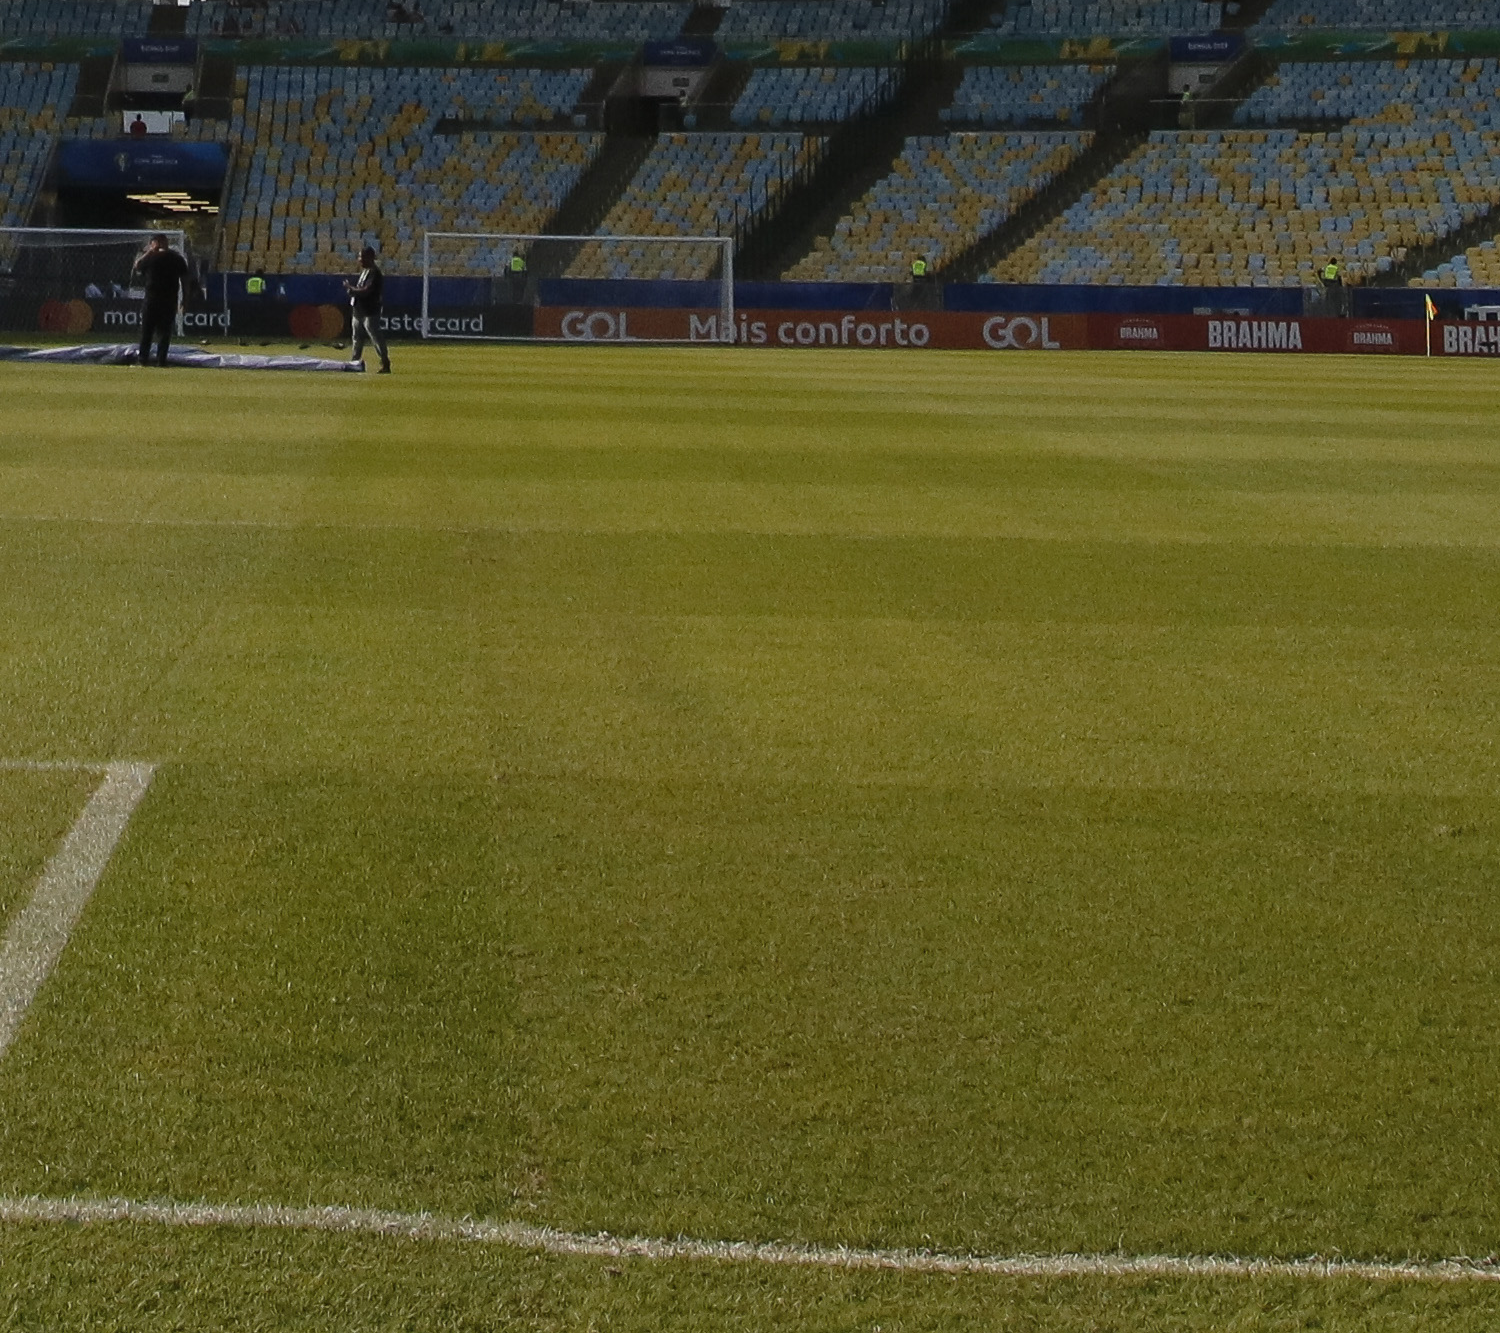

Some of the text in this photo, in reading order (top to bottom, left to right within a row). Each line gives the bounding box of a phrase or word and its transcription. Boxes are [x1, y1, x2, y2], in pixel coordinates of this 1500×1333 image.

[380, 313, 483, 332] astercard
[561, 310, 637, 340] GOL
[688, 314, 930, 347] Mais conforto
[982, 316, 1061, 349] GOL
[1119, 326, 1159, 340] BRAHMA
[1207, 320, 1303, 350] BRAHMA
[1353, 332, 1394, 346] BRAHMA
